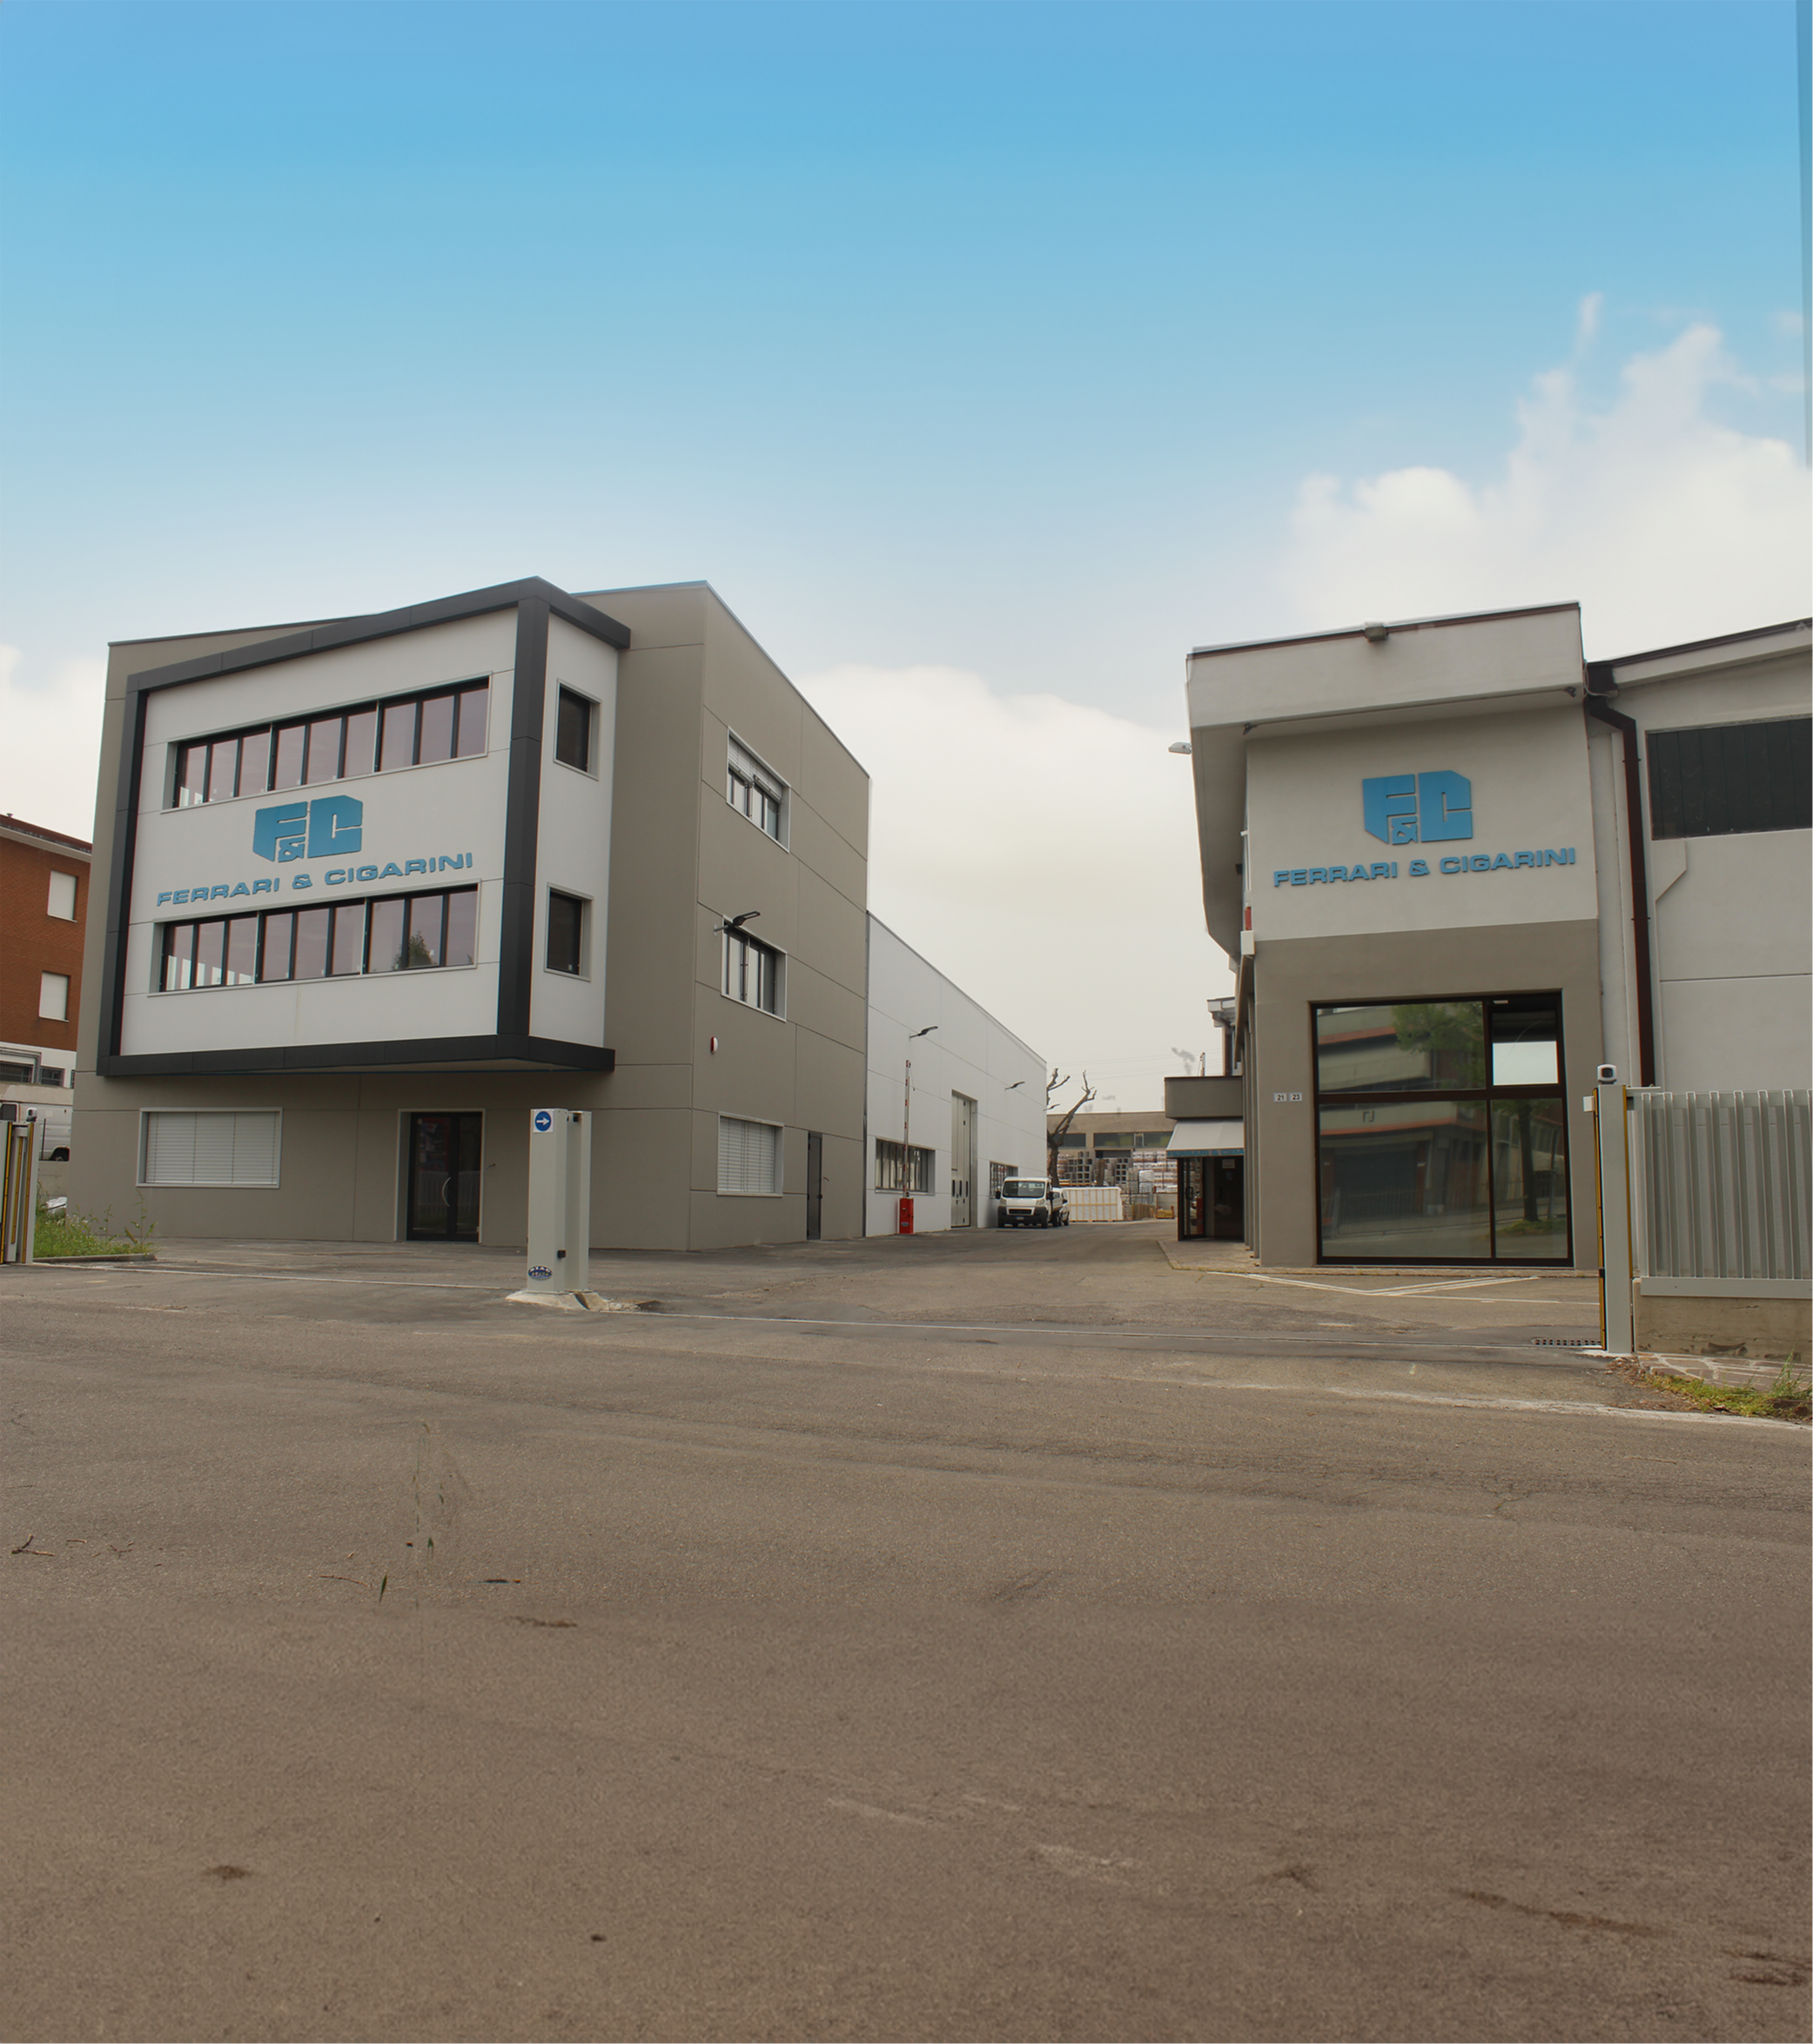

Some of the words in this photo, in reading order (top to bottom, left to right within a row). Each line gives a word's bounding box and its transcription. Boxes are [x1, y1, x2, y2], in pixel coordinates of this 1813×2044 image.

[157, 877, 280, 907] FERRARI
[292, 873, 313, 889] &
[324, 852, 473, 885] CIGARINI
[1273, 861, 1399, 887] FERRARI
[1408, 858, 1430, 876] &
[1440, 846, 1576, 875] CIGARINI
